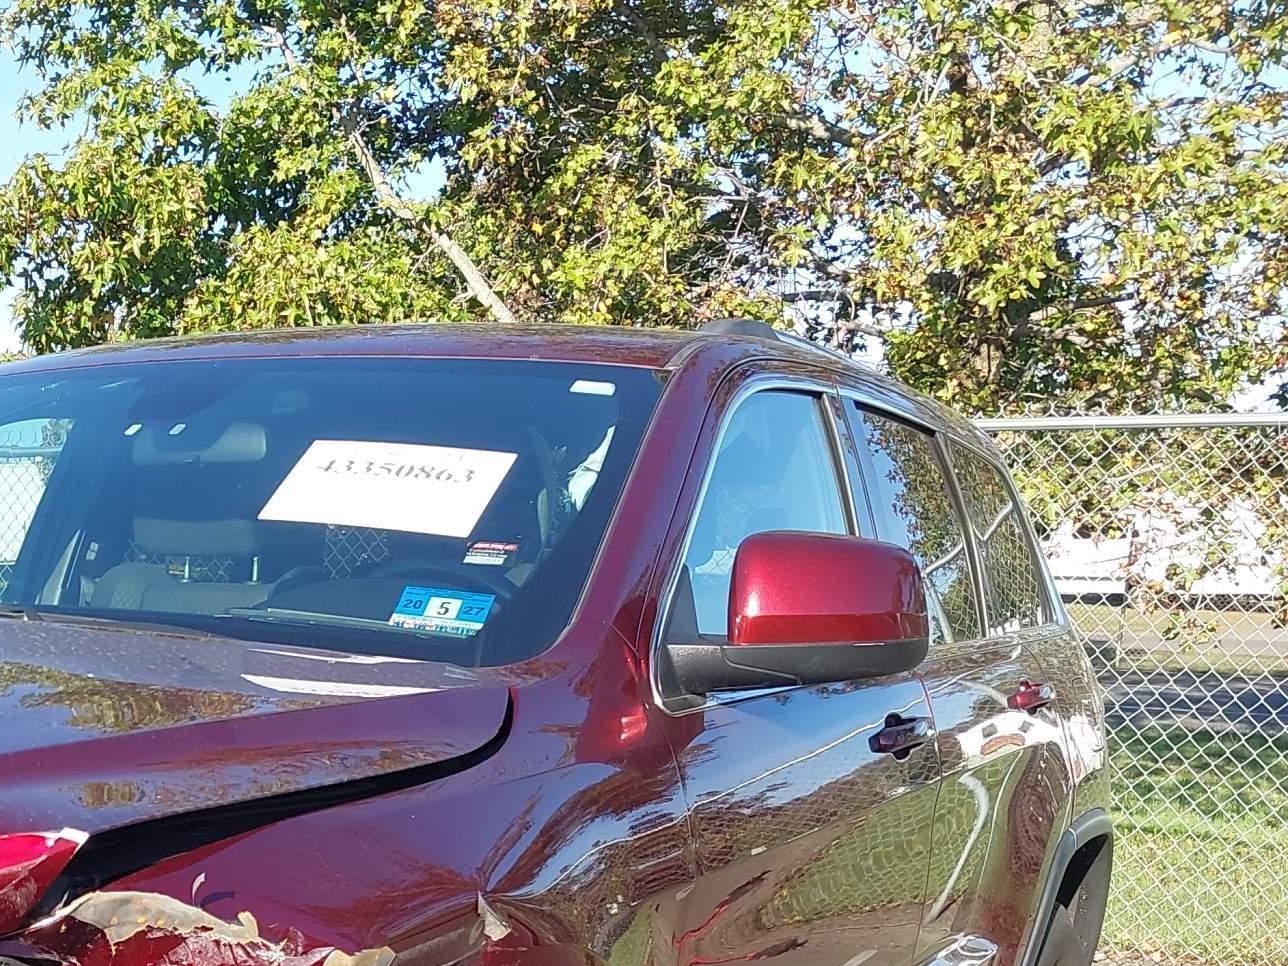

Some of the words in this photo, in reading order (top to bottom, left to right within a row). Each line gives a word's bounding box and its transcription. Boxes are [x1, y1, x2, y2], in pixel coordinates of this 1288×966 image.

[316, 459, 475, 483] 43350863
[403, 599, 424, 610] 20
[437, 601, 452, 616] 5
[463, 605, 486, 616] 27
